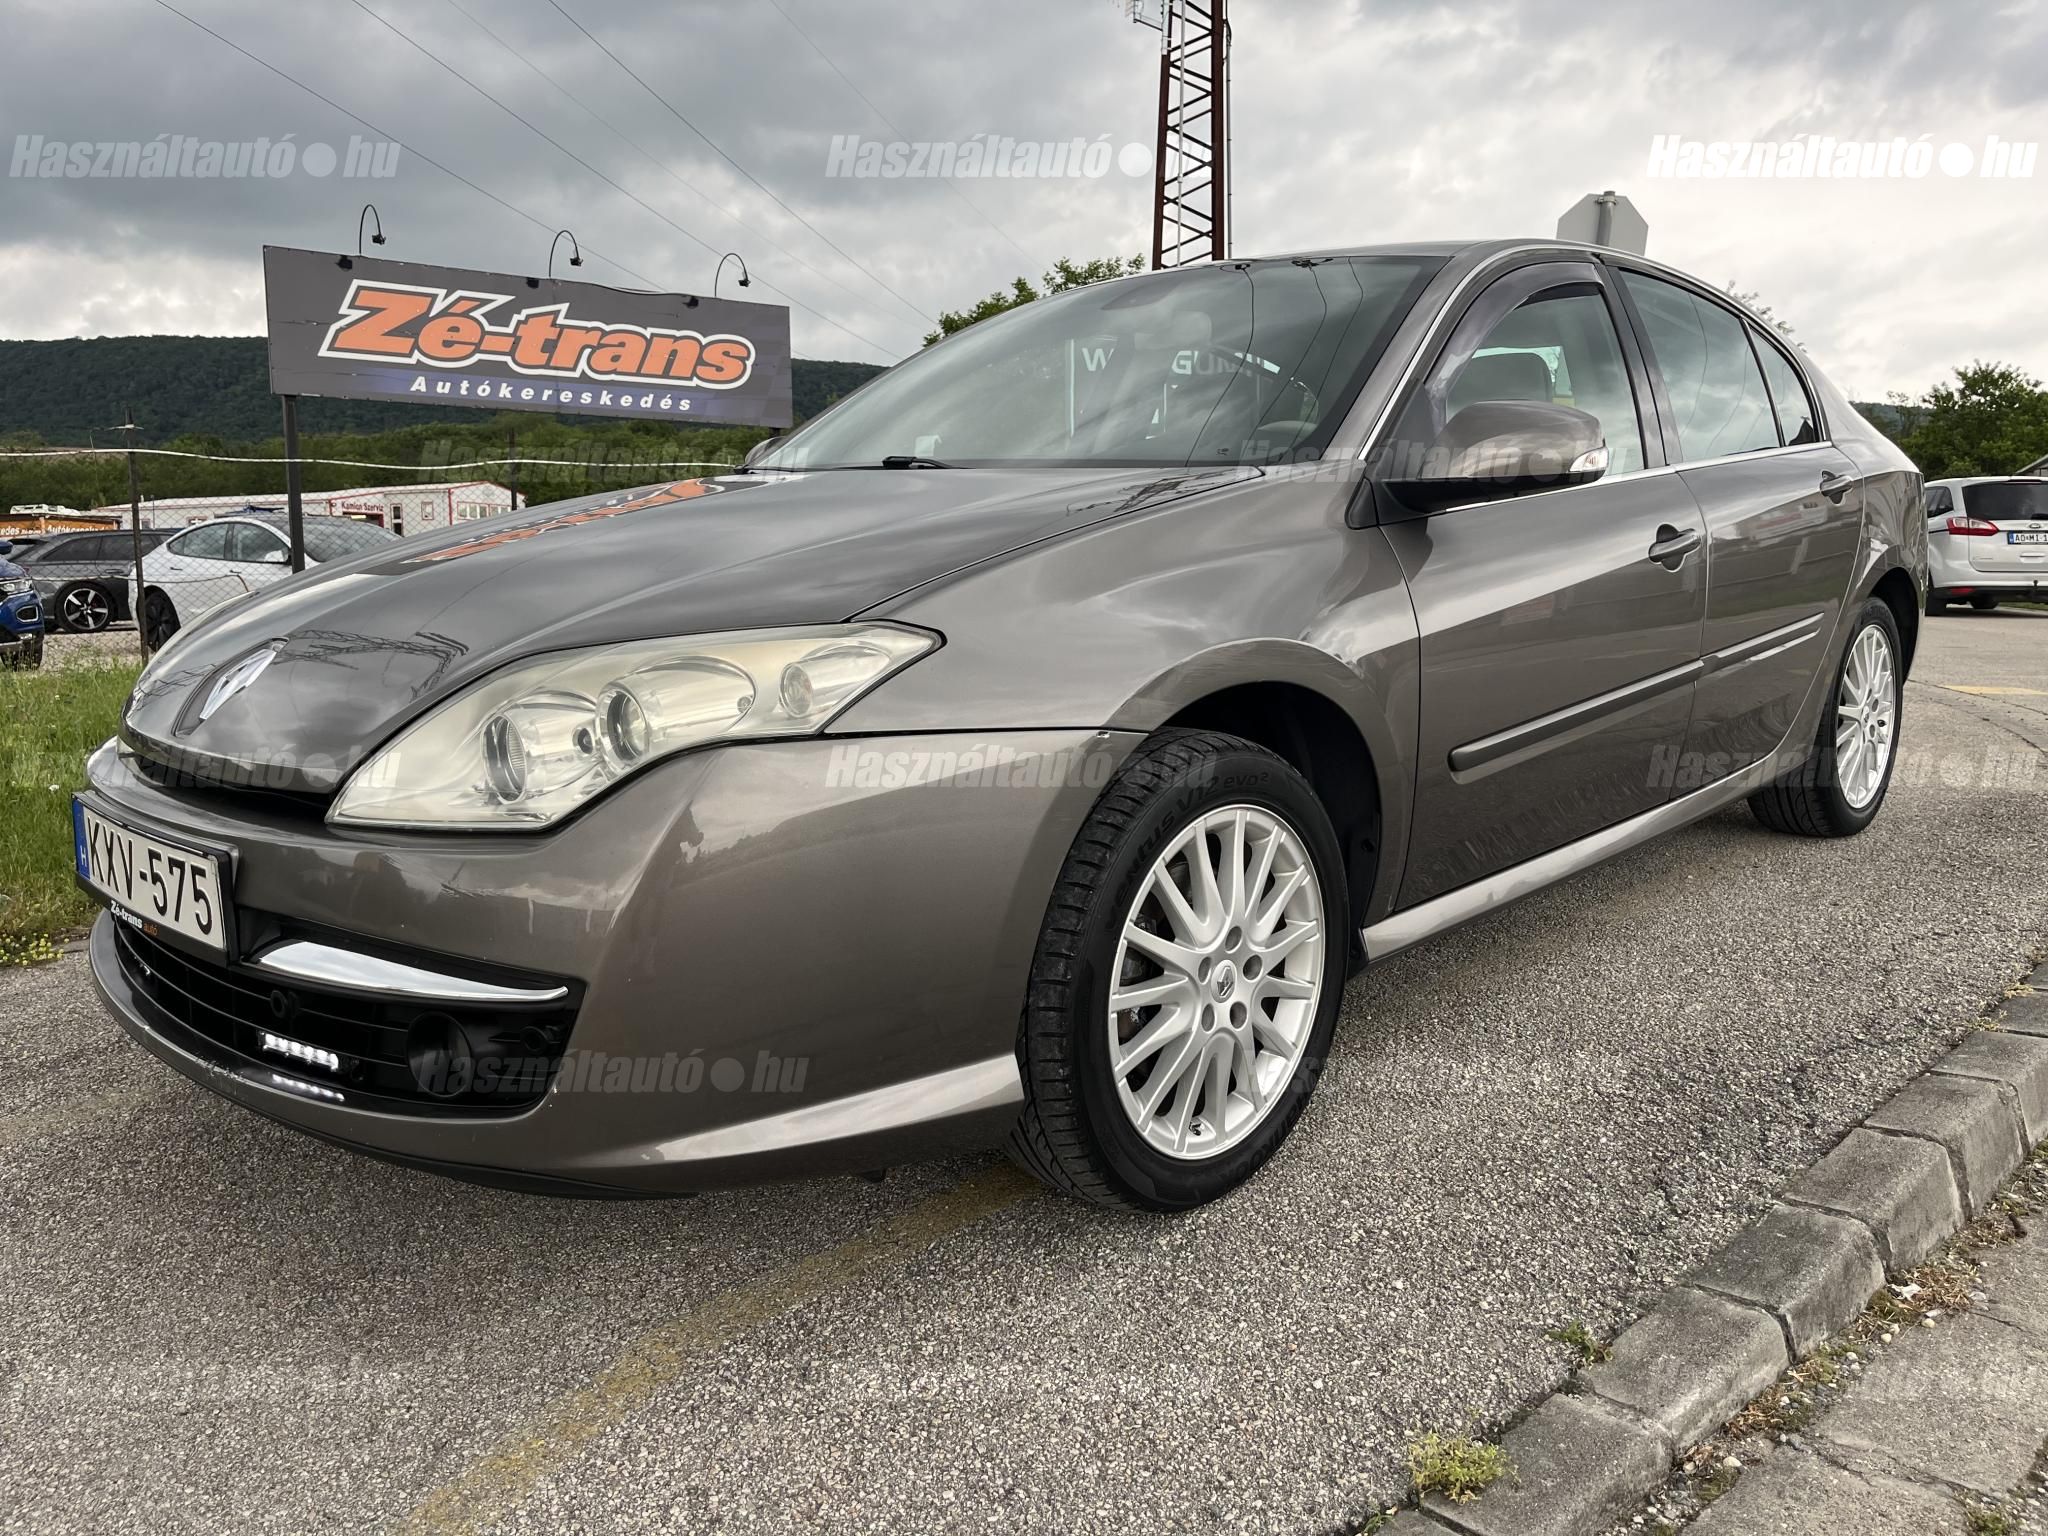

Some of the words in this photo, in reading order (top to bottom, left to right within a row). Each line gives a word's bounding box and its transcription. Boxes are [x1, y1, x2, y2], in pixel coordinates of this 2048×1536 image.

[318, 279, 756, 388] Zé-trans
[410, 375, 694, 411] Autókereskedés
[87, 816, 213, 935] KXV-575
